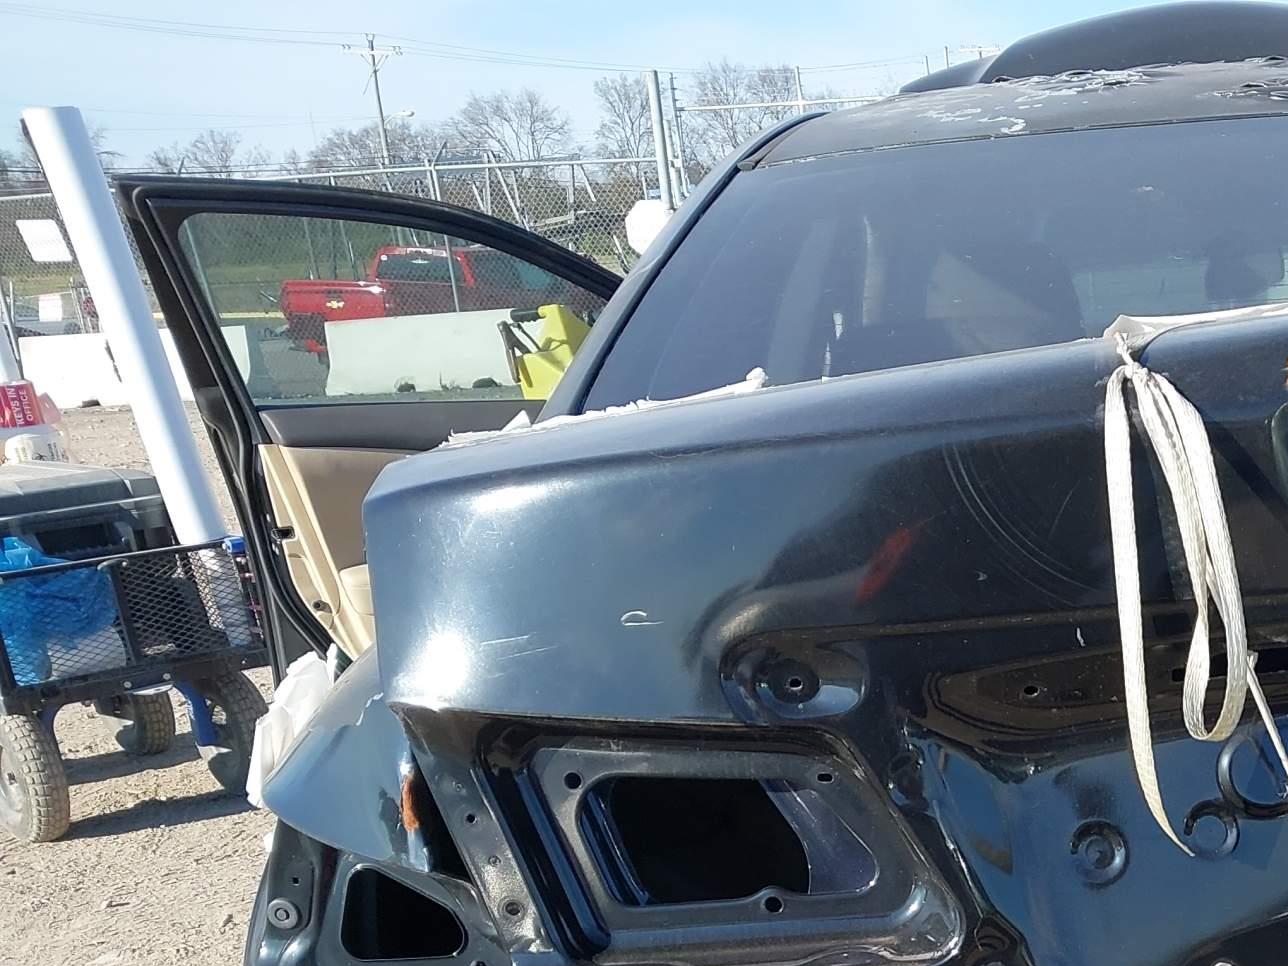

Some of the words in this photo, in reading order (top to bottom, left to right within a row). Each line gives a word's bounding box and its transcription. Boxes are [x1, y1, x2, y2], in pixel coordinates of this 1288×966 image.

[7, 387, 17, 398] IN
[19, 389, 34, 422] OFFICE
[12, 399, 25, 425] KEYS
